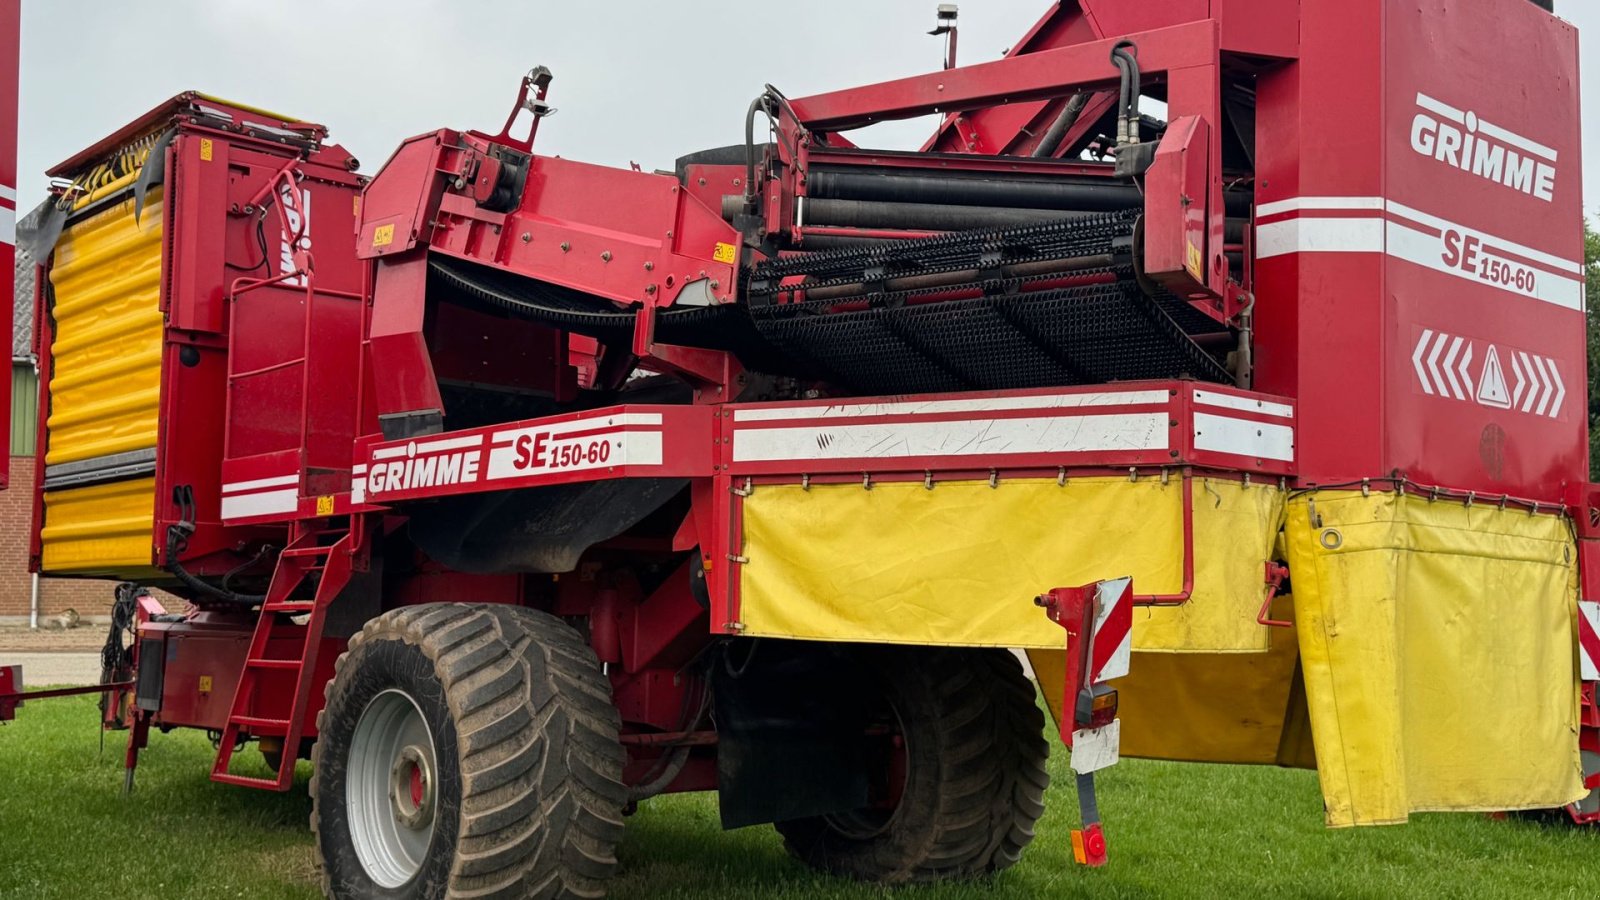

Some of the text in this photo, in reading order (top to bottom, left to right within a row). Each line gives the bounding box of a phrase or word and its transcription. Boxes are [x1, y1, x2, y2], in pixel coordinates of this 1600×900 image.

[1410, 110, 1556, 202] GRIMME
[1441, 229, 1535, 294] SE 150-60
[369, 441, 481, 493] GRIMME
[513, 432, 610, 470] SE 150-60
